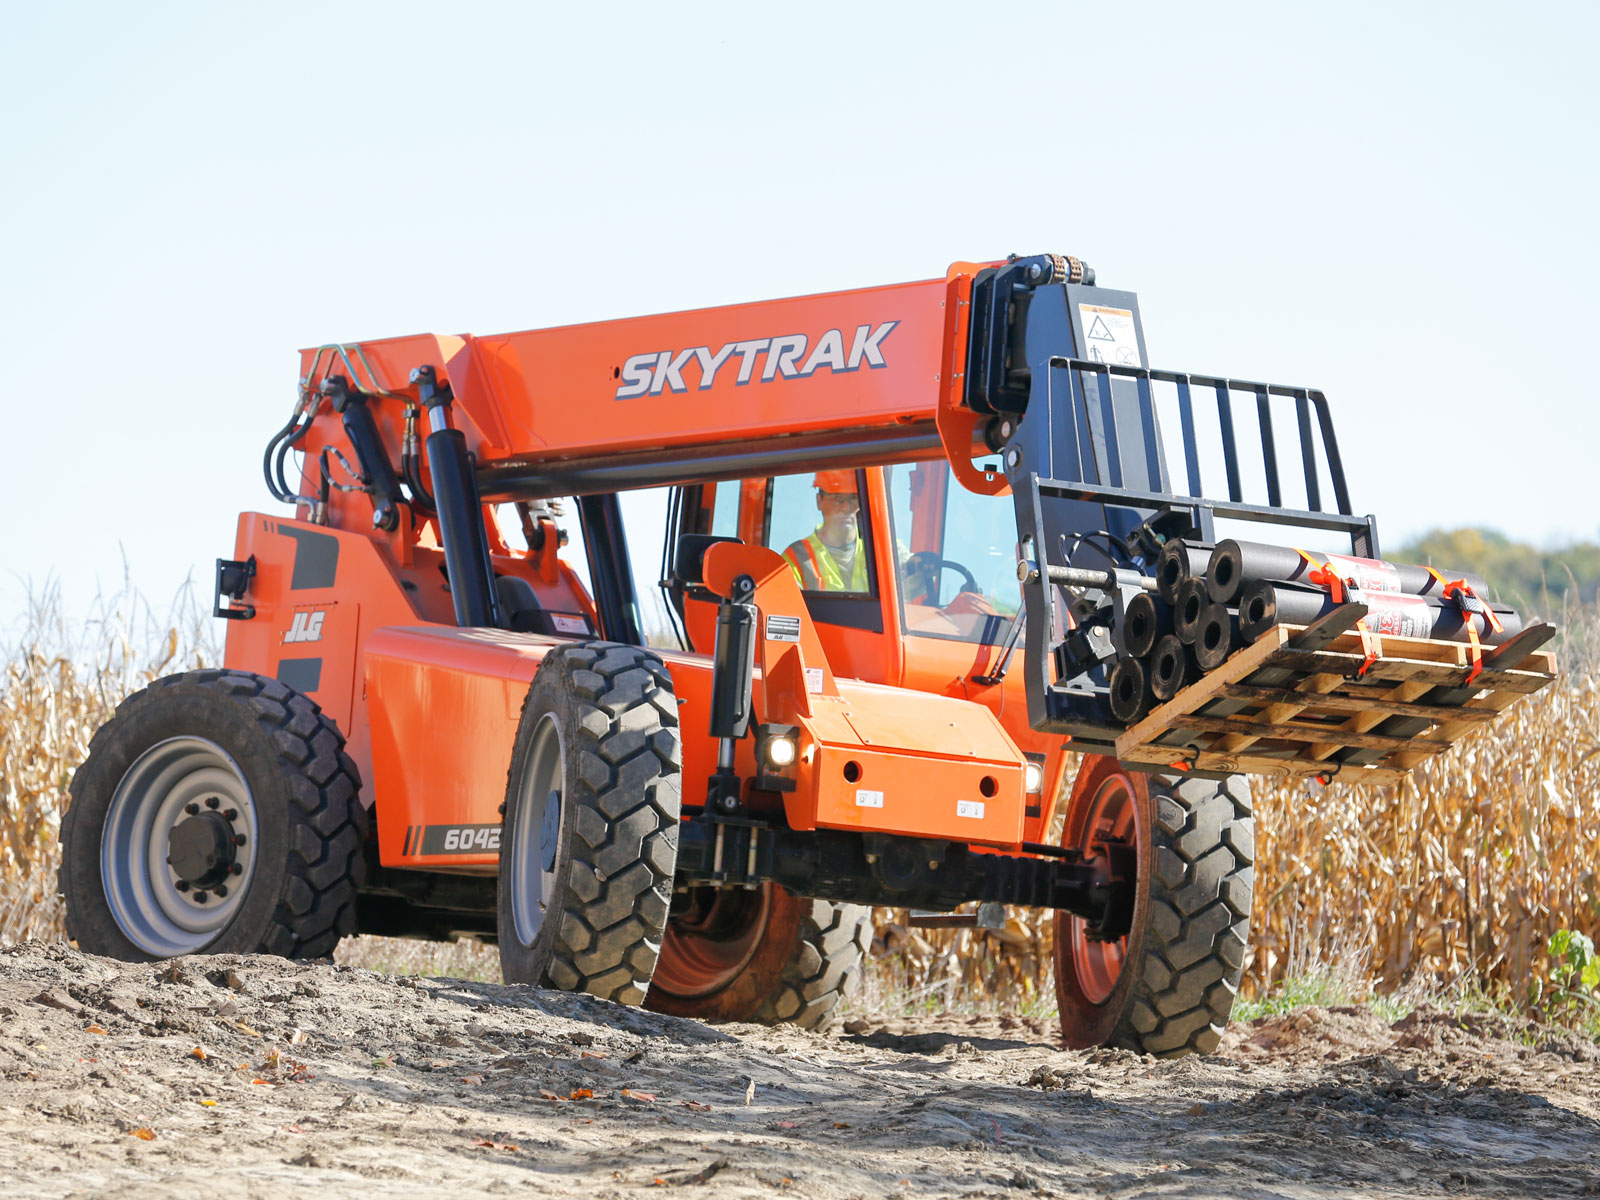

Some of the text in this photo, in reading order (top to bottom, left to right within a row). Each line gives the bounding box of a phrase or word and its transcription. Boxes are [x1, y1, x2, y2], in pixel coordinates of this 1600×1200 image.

[615, 320, 901, 400] SKYTRAK
[284, 611, 325, 643] JLG
[444, 828, 501, 850] 6042
